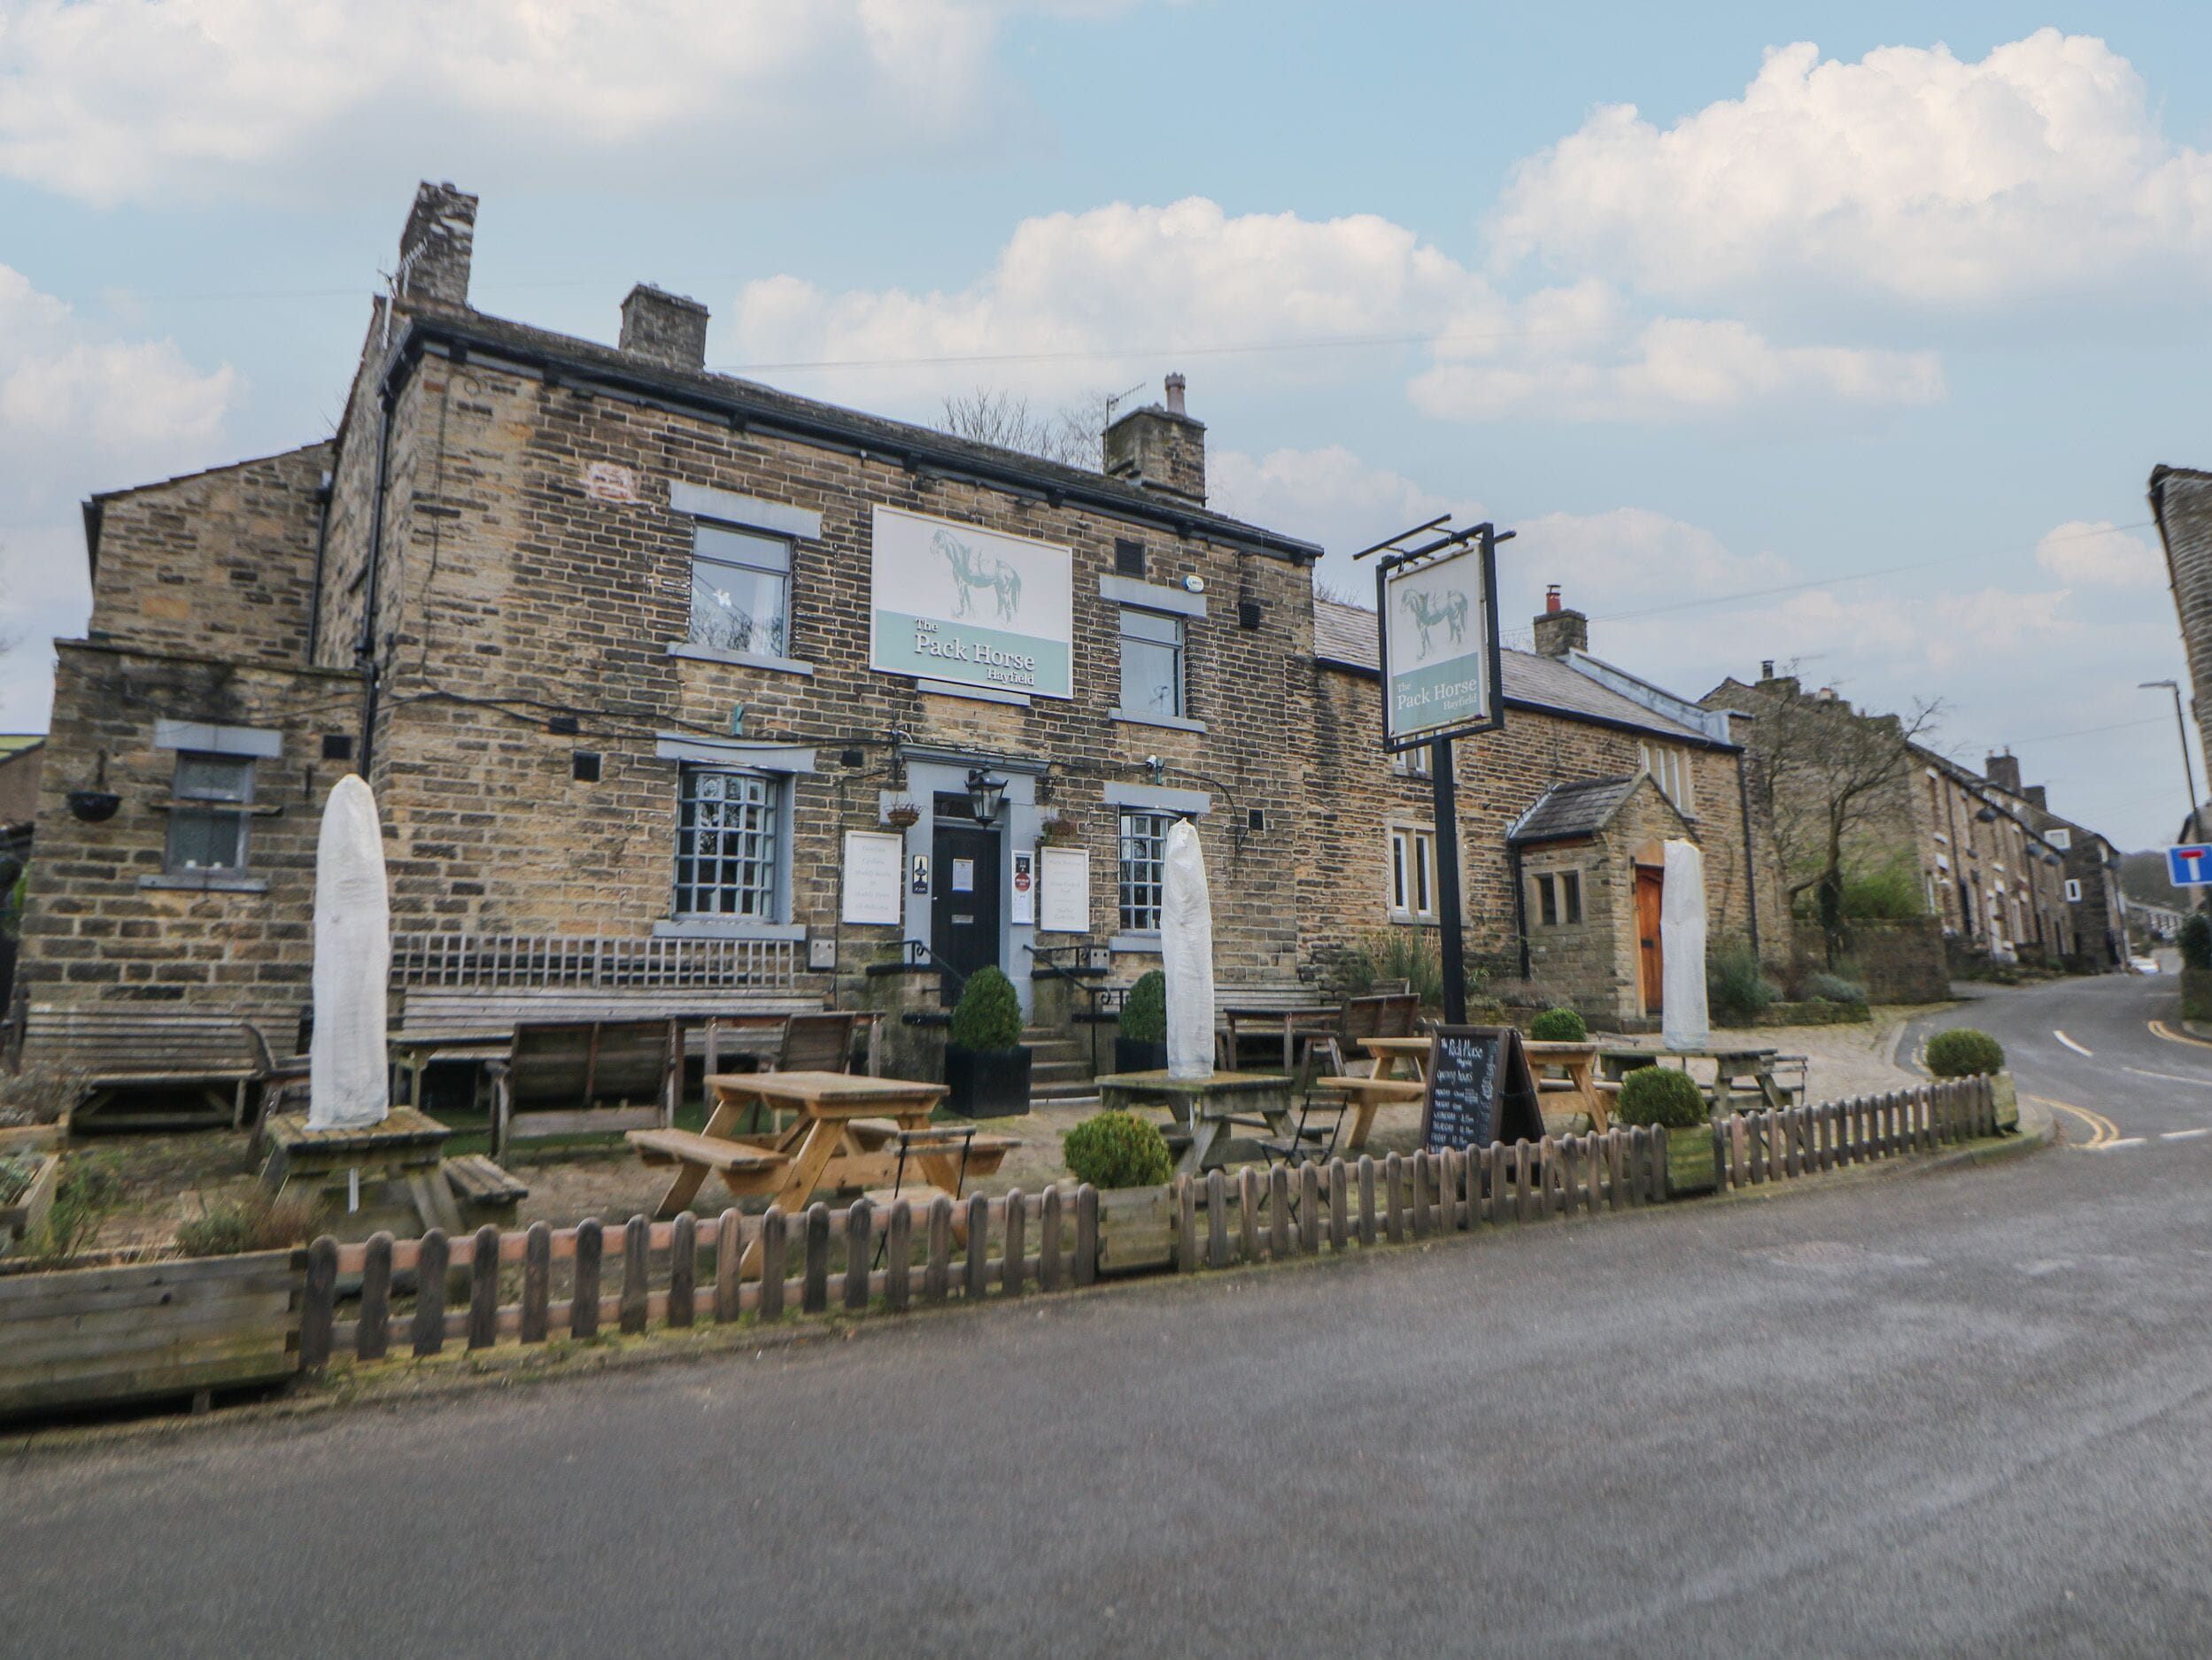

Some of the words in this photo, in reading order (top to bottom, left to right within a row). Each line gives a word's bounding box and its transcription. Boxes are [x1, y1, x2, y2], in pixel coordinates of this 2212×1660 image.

[915, 618, 939, 632] The
[915, 632, 968, 660] Pack
[973, 643, 1035, 671] Horse
[986, 668, 1035, 686] Hayfield
[1397, 681, 1412, 692] The
[1397, 687, 1431, 710] Pack
[1434, 678, 1477, 701] Horse
[1443, 693, 1477, 710] Hayfield
